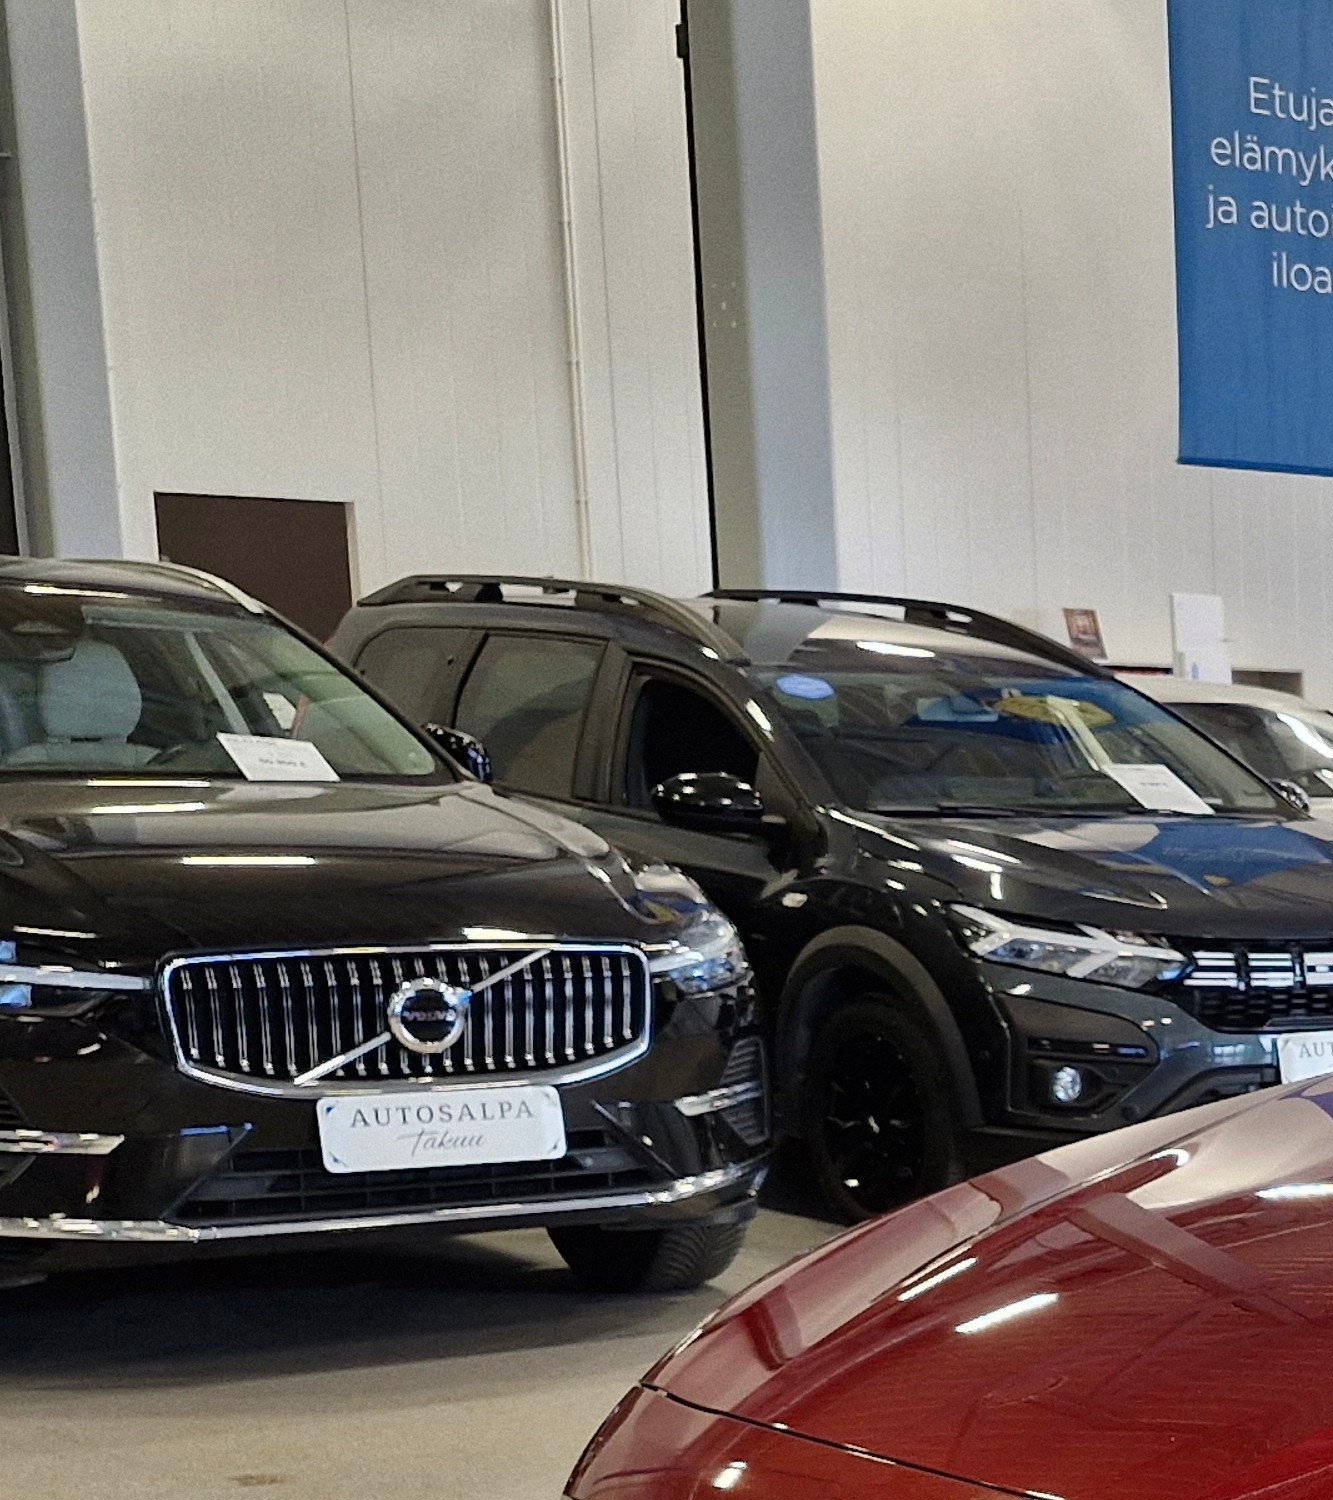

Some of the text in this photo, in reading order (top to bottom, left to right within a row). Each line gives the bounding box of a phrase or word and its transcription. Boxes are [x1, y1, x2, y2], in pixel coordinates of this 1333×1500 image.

[1205, 184, 1238, 229] ja
[1272, 251, 1333, 294] iloa
[351, 1100, 535, 1129] AUTOSALPA
[397, 1129, 487, 1157] Takuu
